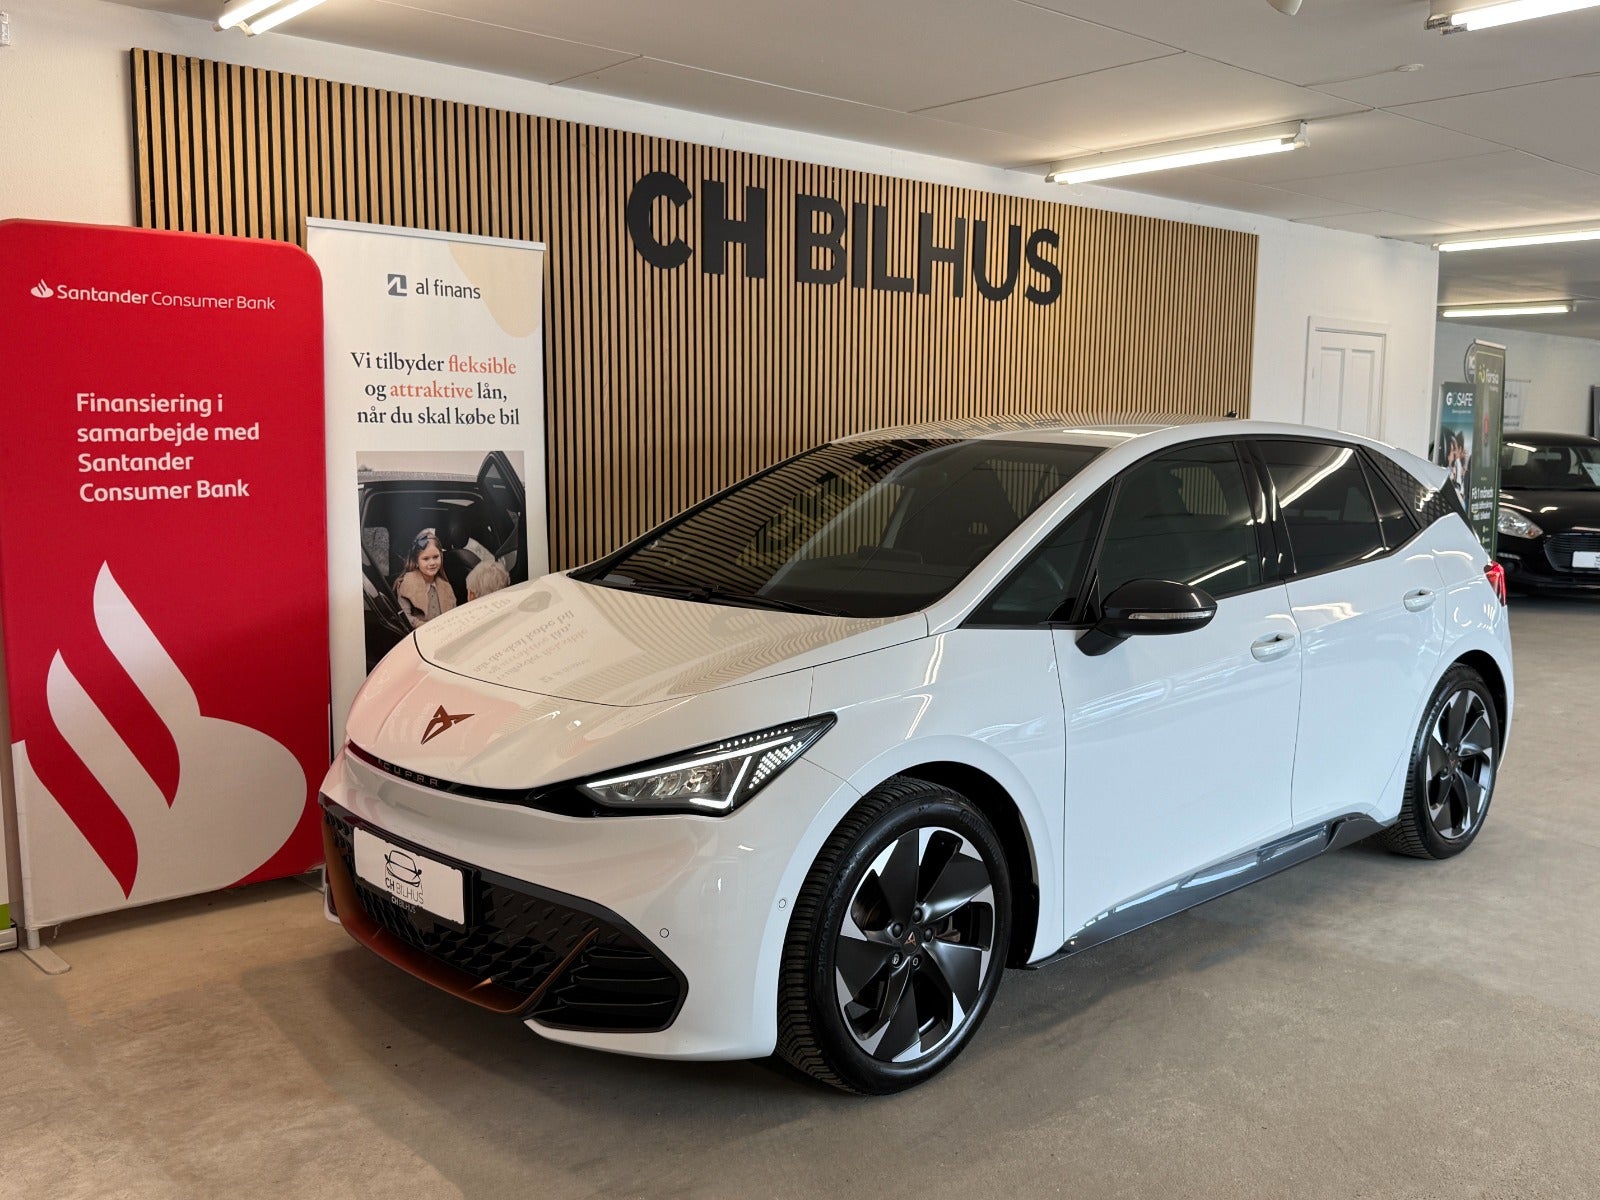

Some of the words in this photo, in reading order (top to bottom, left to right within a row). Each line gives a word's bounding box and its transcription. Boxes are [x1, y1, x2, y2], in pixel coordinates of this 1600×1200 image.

[627, 171, 766, 279] CH
[796, 193, 1063, 306] BILHUS
[57, 284, 149, 304] Santander
[151, 291, 234, 309] Consumer
[236, 296, 276, 310] Bank
[415, 278, 429, 296] al
[434, 280, 481, 300] finans
[350, 352, 371, 369] Vi
[376, 352, 445, 375] tilbyder
[448, 354, 517, 375] fleksible
[365, 384, 386, 401] og
[390, 380, 473, 399] attraktive
[477, 382, 507, 402] lån,
[76, 392, 212, 417] Finansiering
[217, 394, 223, 412] i
[357, 406, 386, 424] når
[391, 406, 413, 424] du
[417, 407, 451, 425] skal
[455, 408, 496, 425] købe
[500, 408, 520, 425] bil
[77, 423, 208, 447] samarbejde
[214, 422, 260, 441] med
[78, 452, 194, 473] Santander
[79, 482, 192, 503] Consumer
[196, 478, 250, 499] Bank
[384, 761, 439, 787] CUPRA
[385, 876, 395, 892] CH
[396, 882, 424, 905] BILHUS
